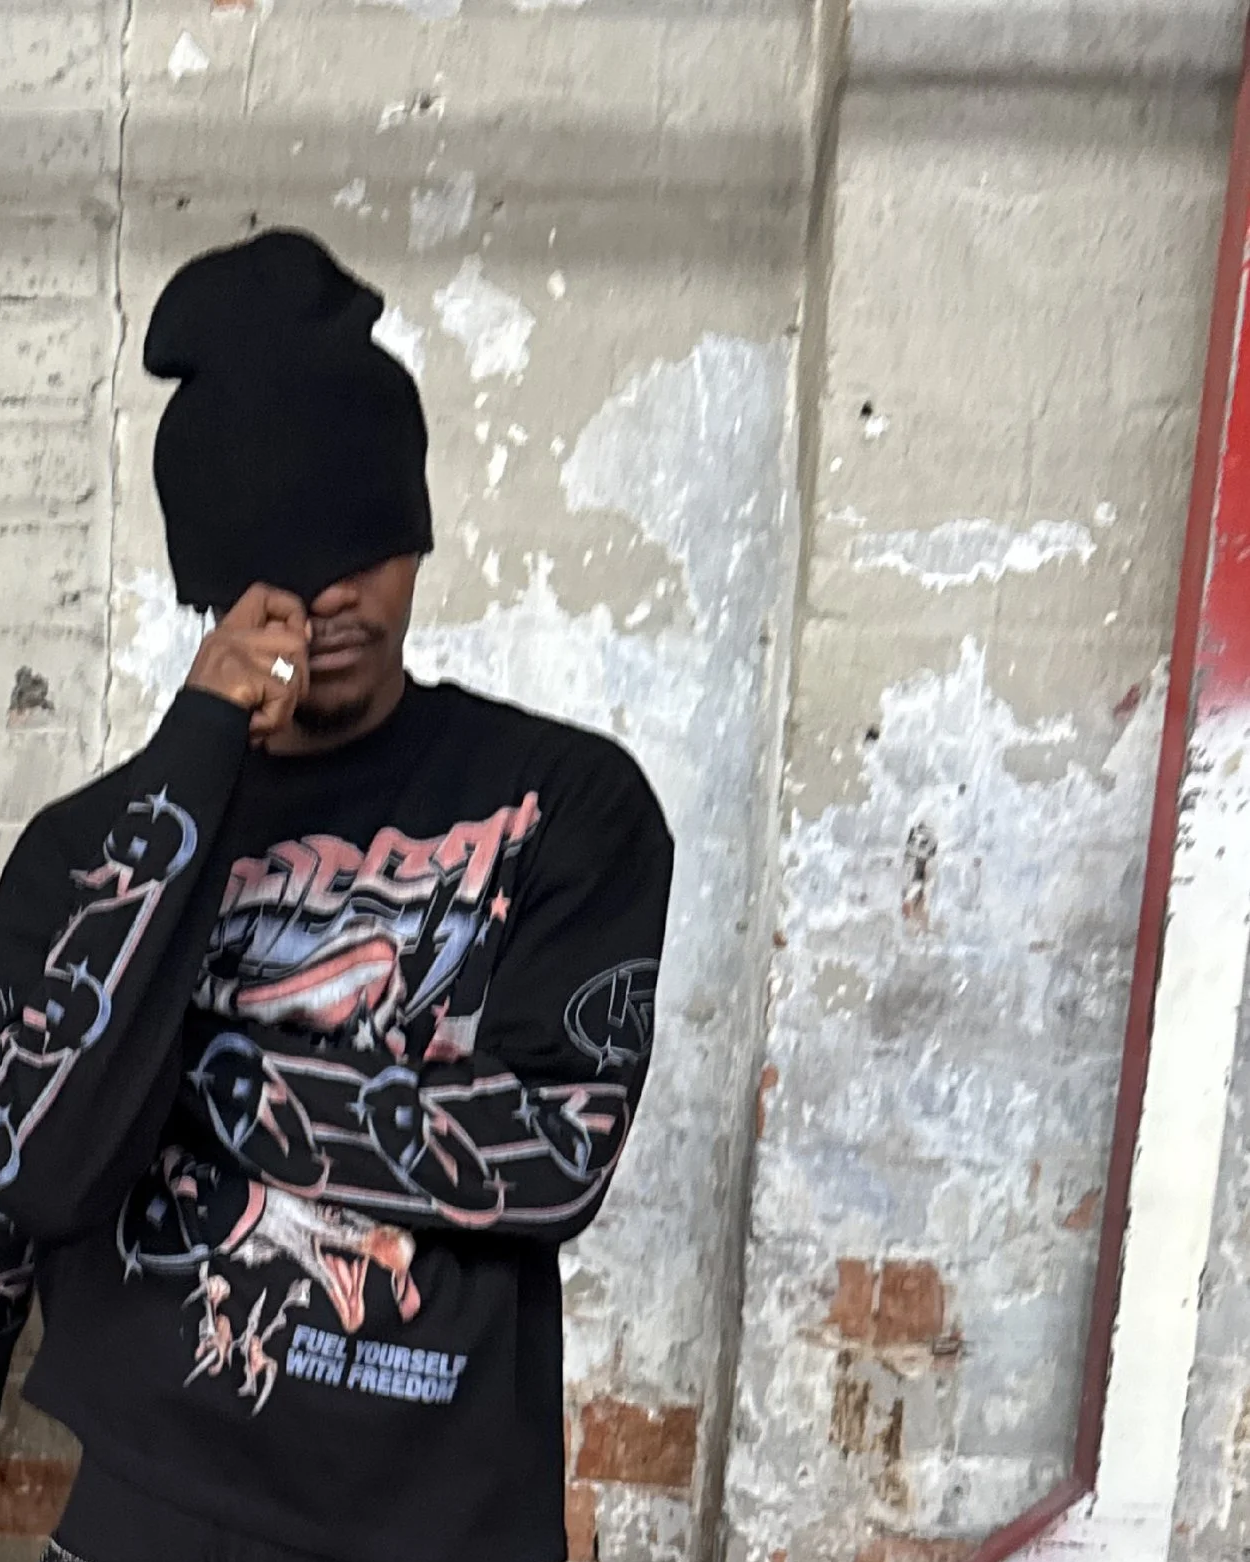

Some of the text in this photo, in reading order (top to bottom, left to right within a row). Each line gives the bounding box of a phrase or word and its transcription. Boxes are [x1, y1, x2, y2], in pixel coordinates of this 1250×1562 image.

[285, 1347, 459, 1404] WITH FREEDOM
[291, 1323, 468, 1378] FUEL YOURSELF
